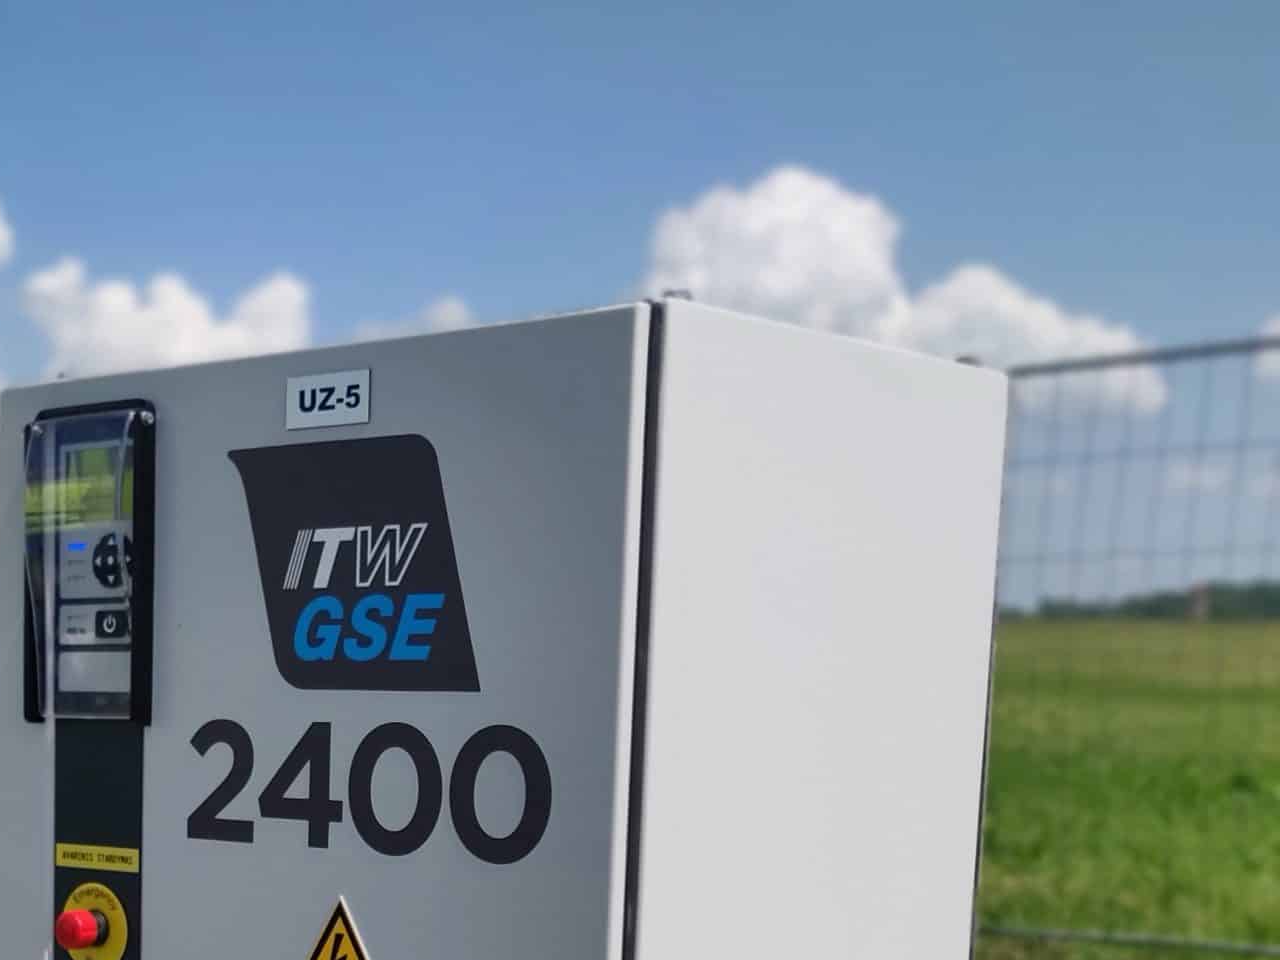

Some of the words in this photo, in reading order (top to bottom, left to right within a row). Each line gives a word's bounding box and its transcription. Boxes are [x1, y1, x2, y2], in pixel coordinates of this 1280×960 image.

[298, 384, 361, 413] UZ-5
[282, 522, 429, 590] ITW
[292, 592, 446, 662] GSE
[186, 718, 552, 865] 2400
